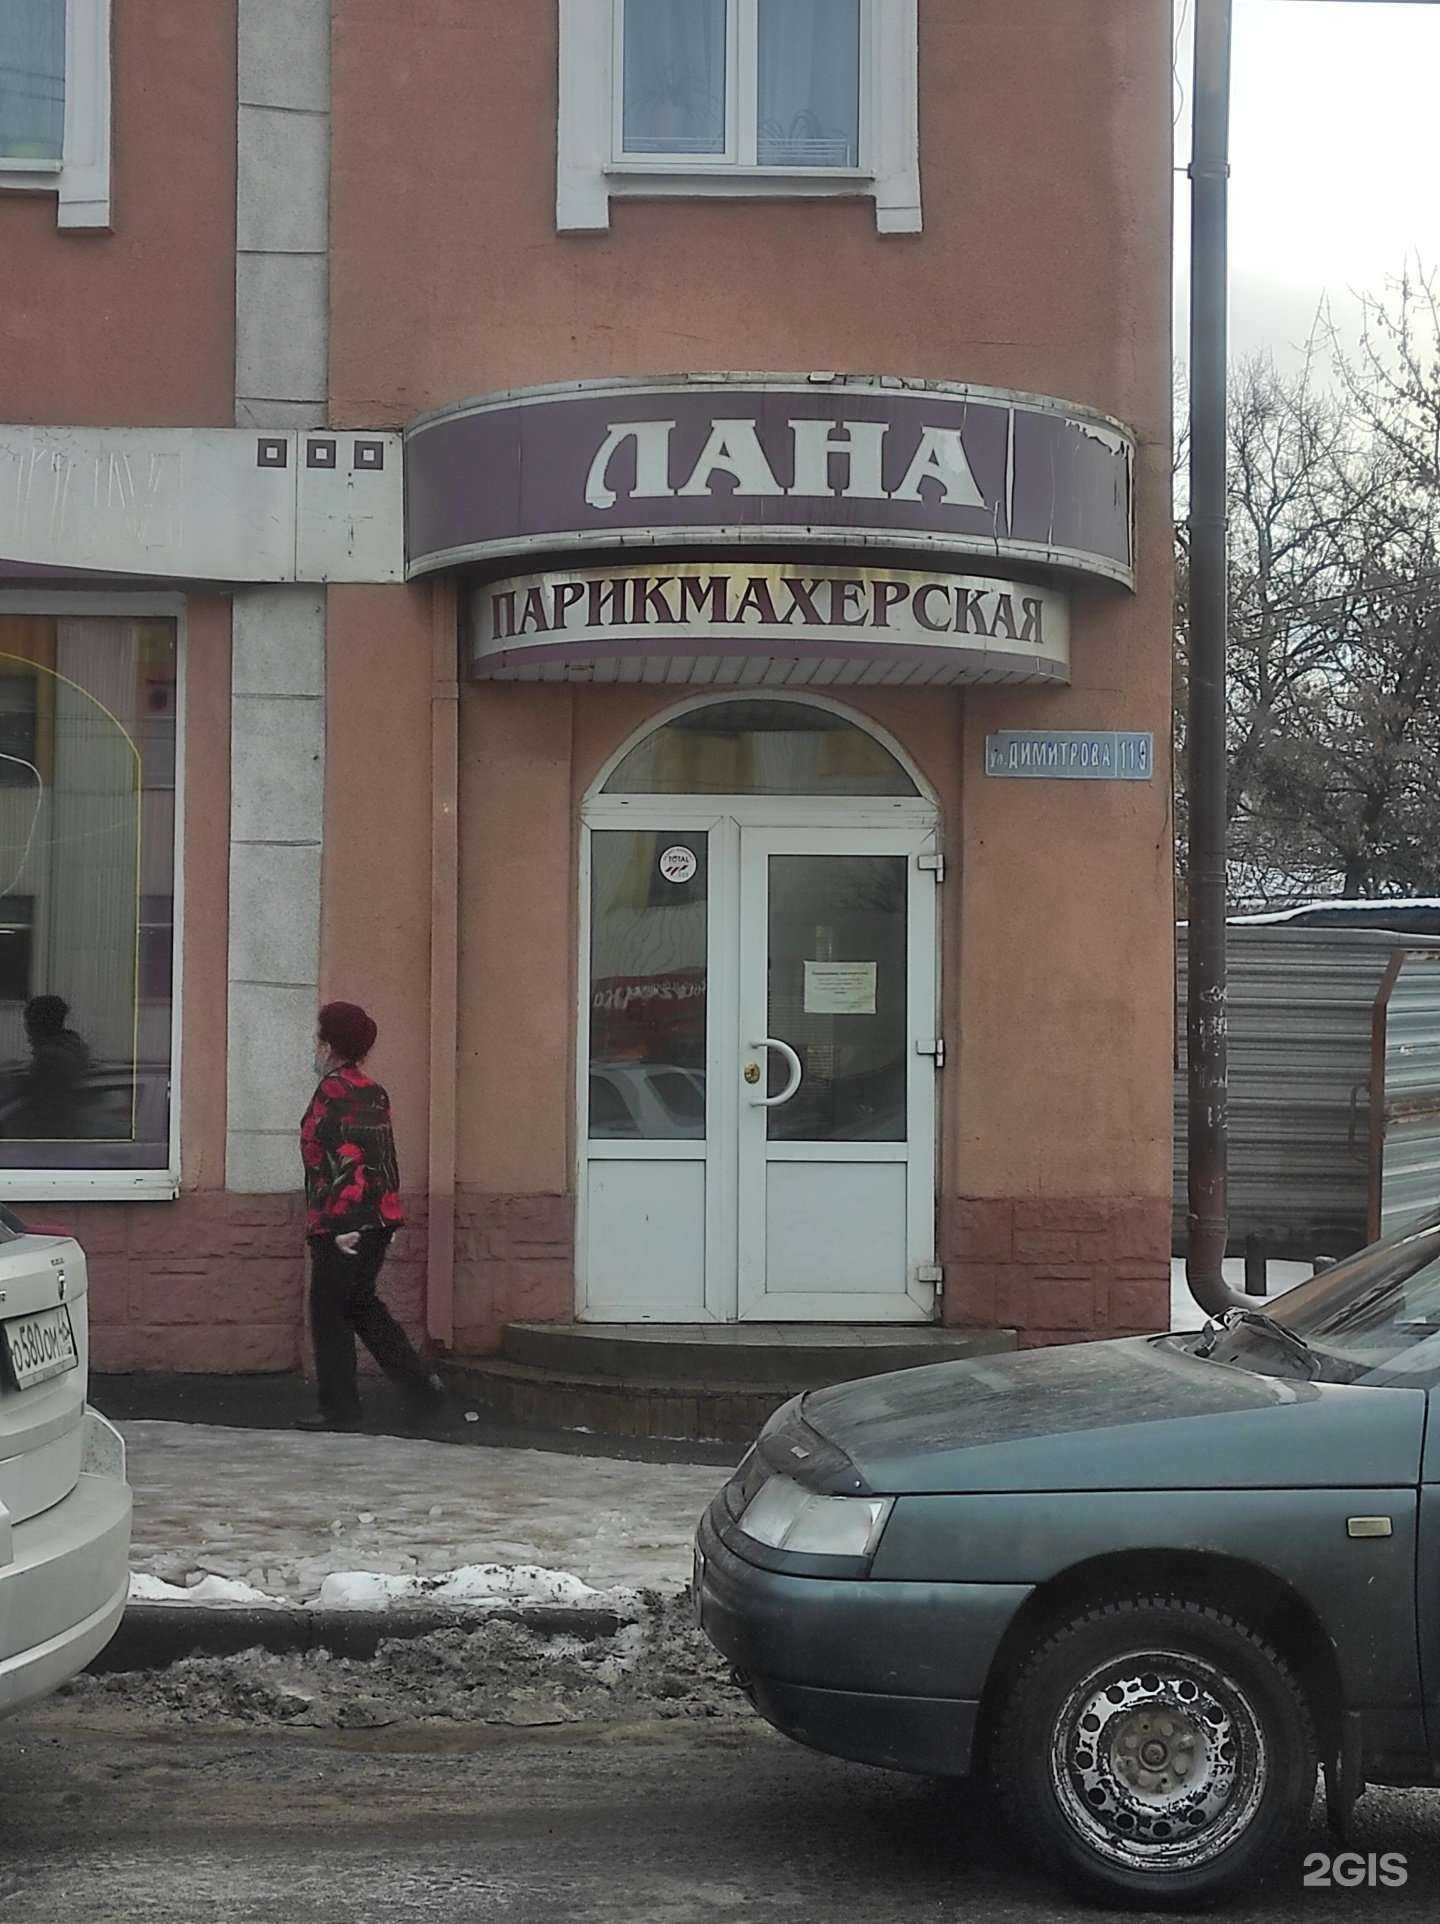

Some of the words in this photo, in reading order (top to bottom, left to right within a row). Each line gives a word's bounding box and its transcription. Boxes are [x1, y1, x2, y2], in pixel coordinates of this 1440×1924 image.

[585, 417, 988, 509] ЛАНА
[491, 576, 1044, 644] ПАРИКМАХЕРСКАЯ
[1008, 741, 1111, 769] ДИМИТРОВА
